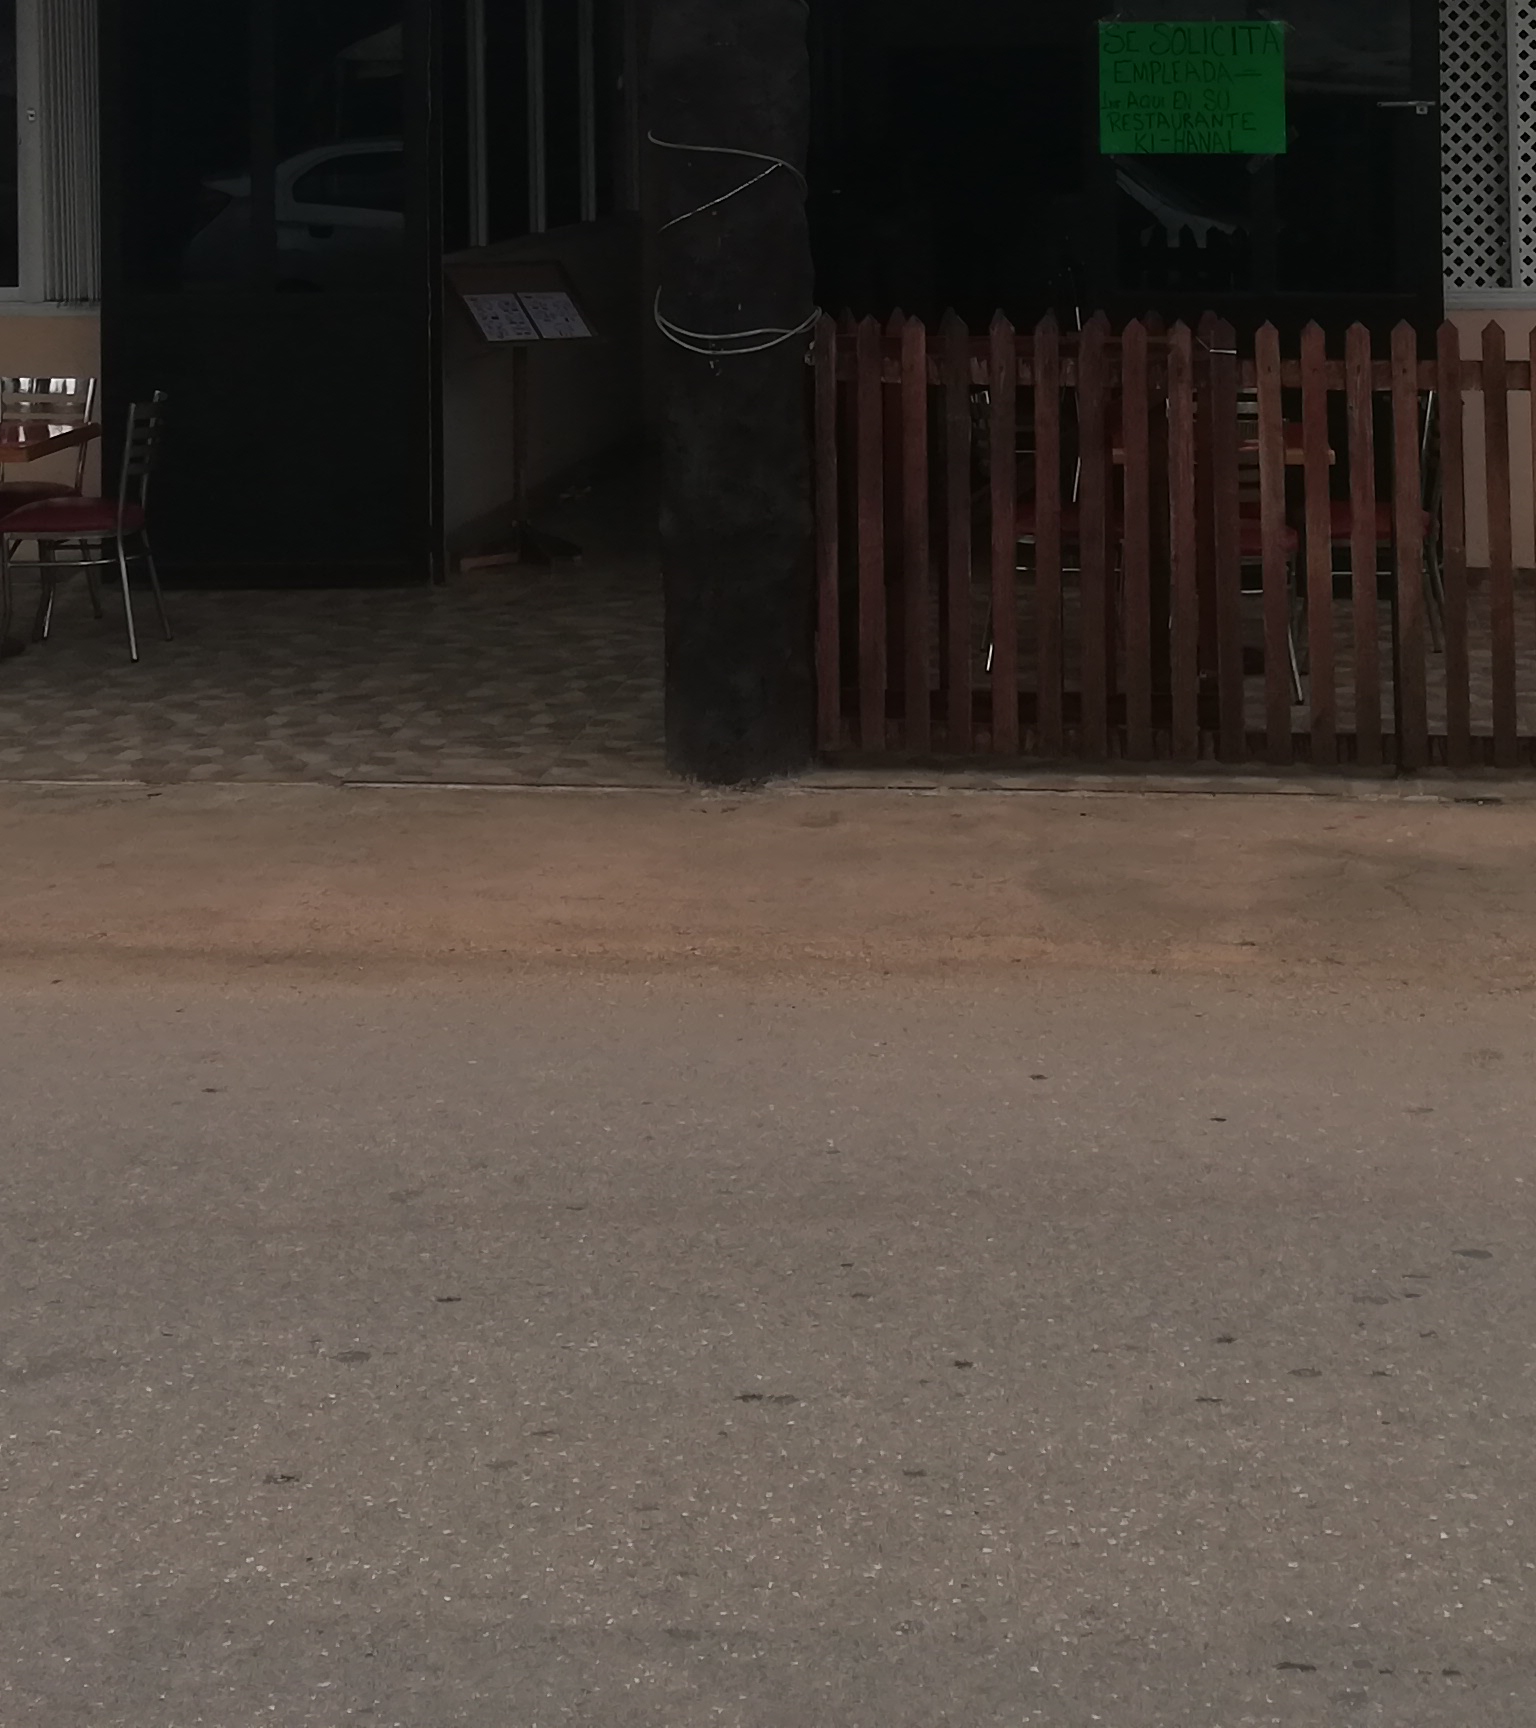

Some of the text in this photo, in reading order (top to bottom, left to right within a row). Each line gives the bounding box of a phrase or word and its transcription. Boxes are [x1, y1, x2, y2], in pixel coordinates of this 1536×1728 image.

[1103, 23, 1280, 56] SE SOLICITA
[1107, 112, 1257, 132] RESTAURANTE
